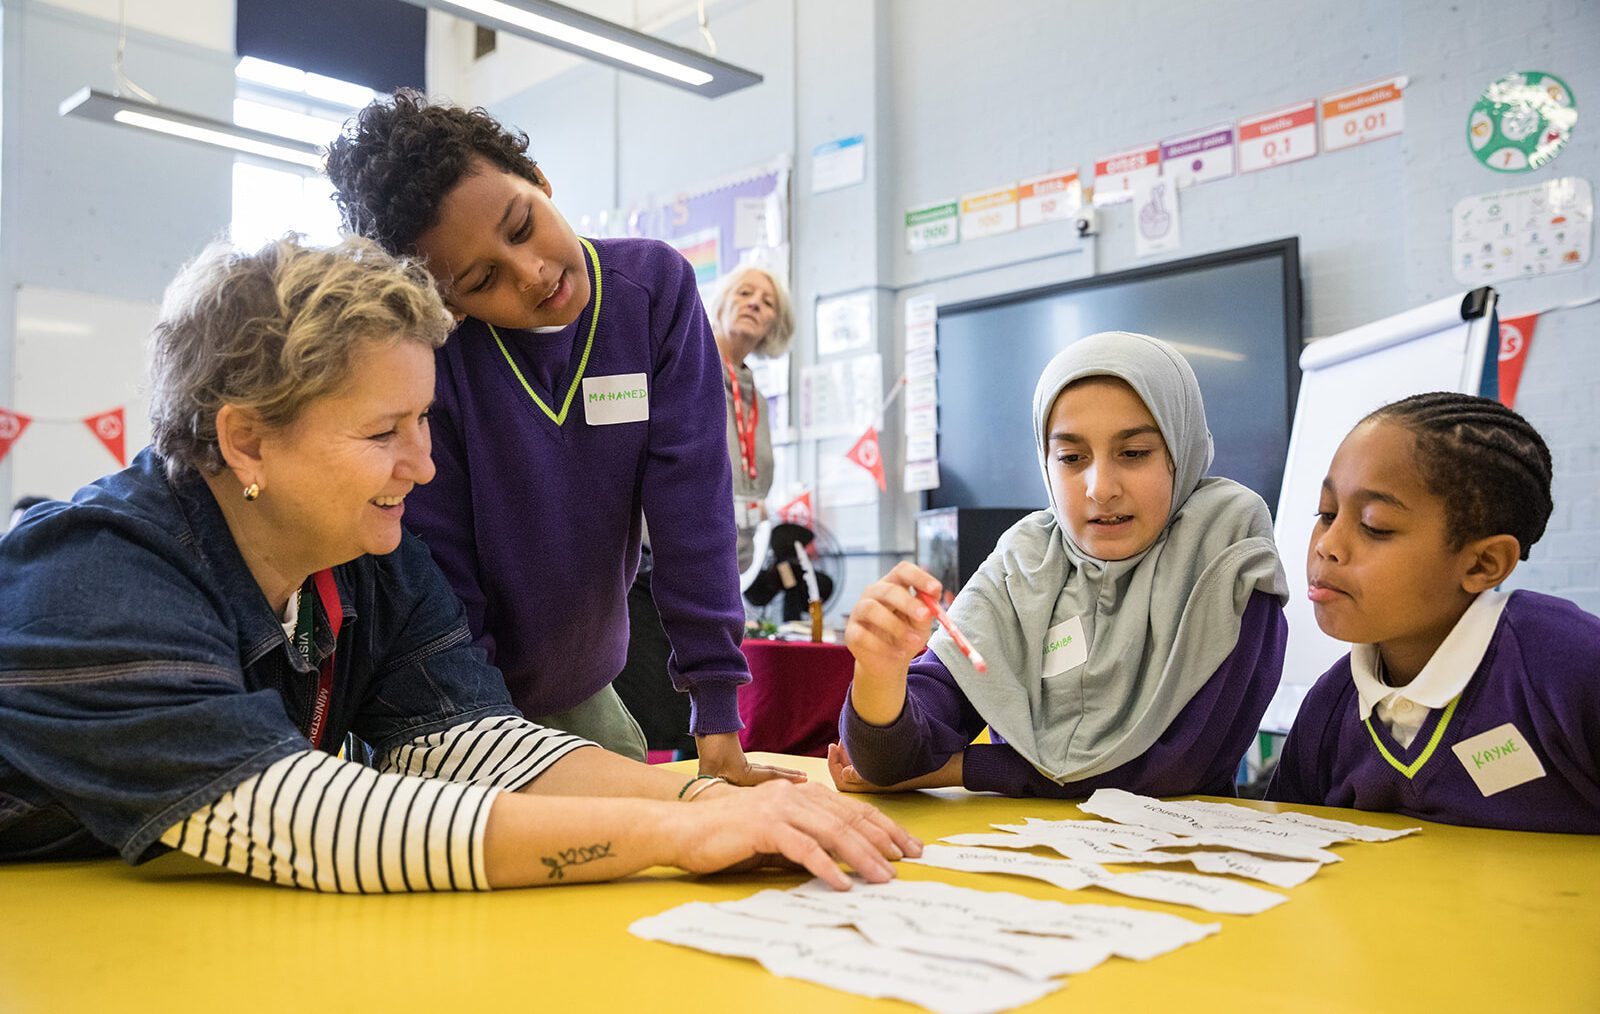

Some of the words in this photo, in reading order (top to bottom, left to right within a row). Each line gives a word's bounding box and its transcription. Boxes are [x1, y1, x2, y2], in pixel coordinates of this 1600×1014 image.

[1343, 111, 1387, 137] 0.01
[1263, 137, 1291, 159] 0.1
[1471, 738, 1520, 769] KAYNE
